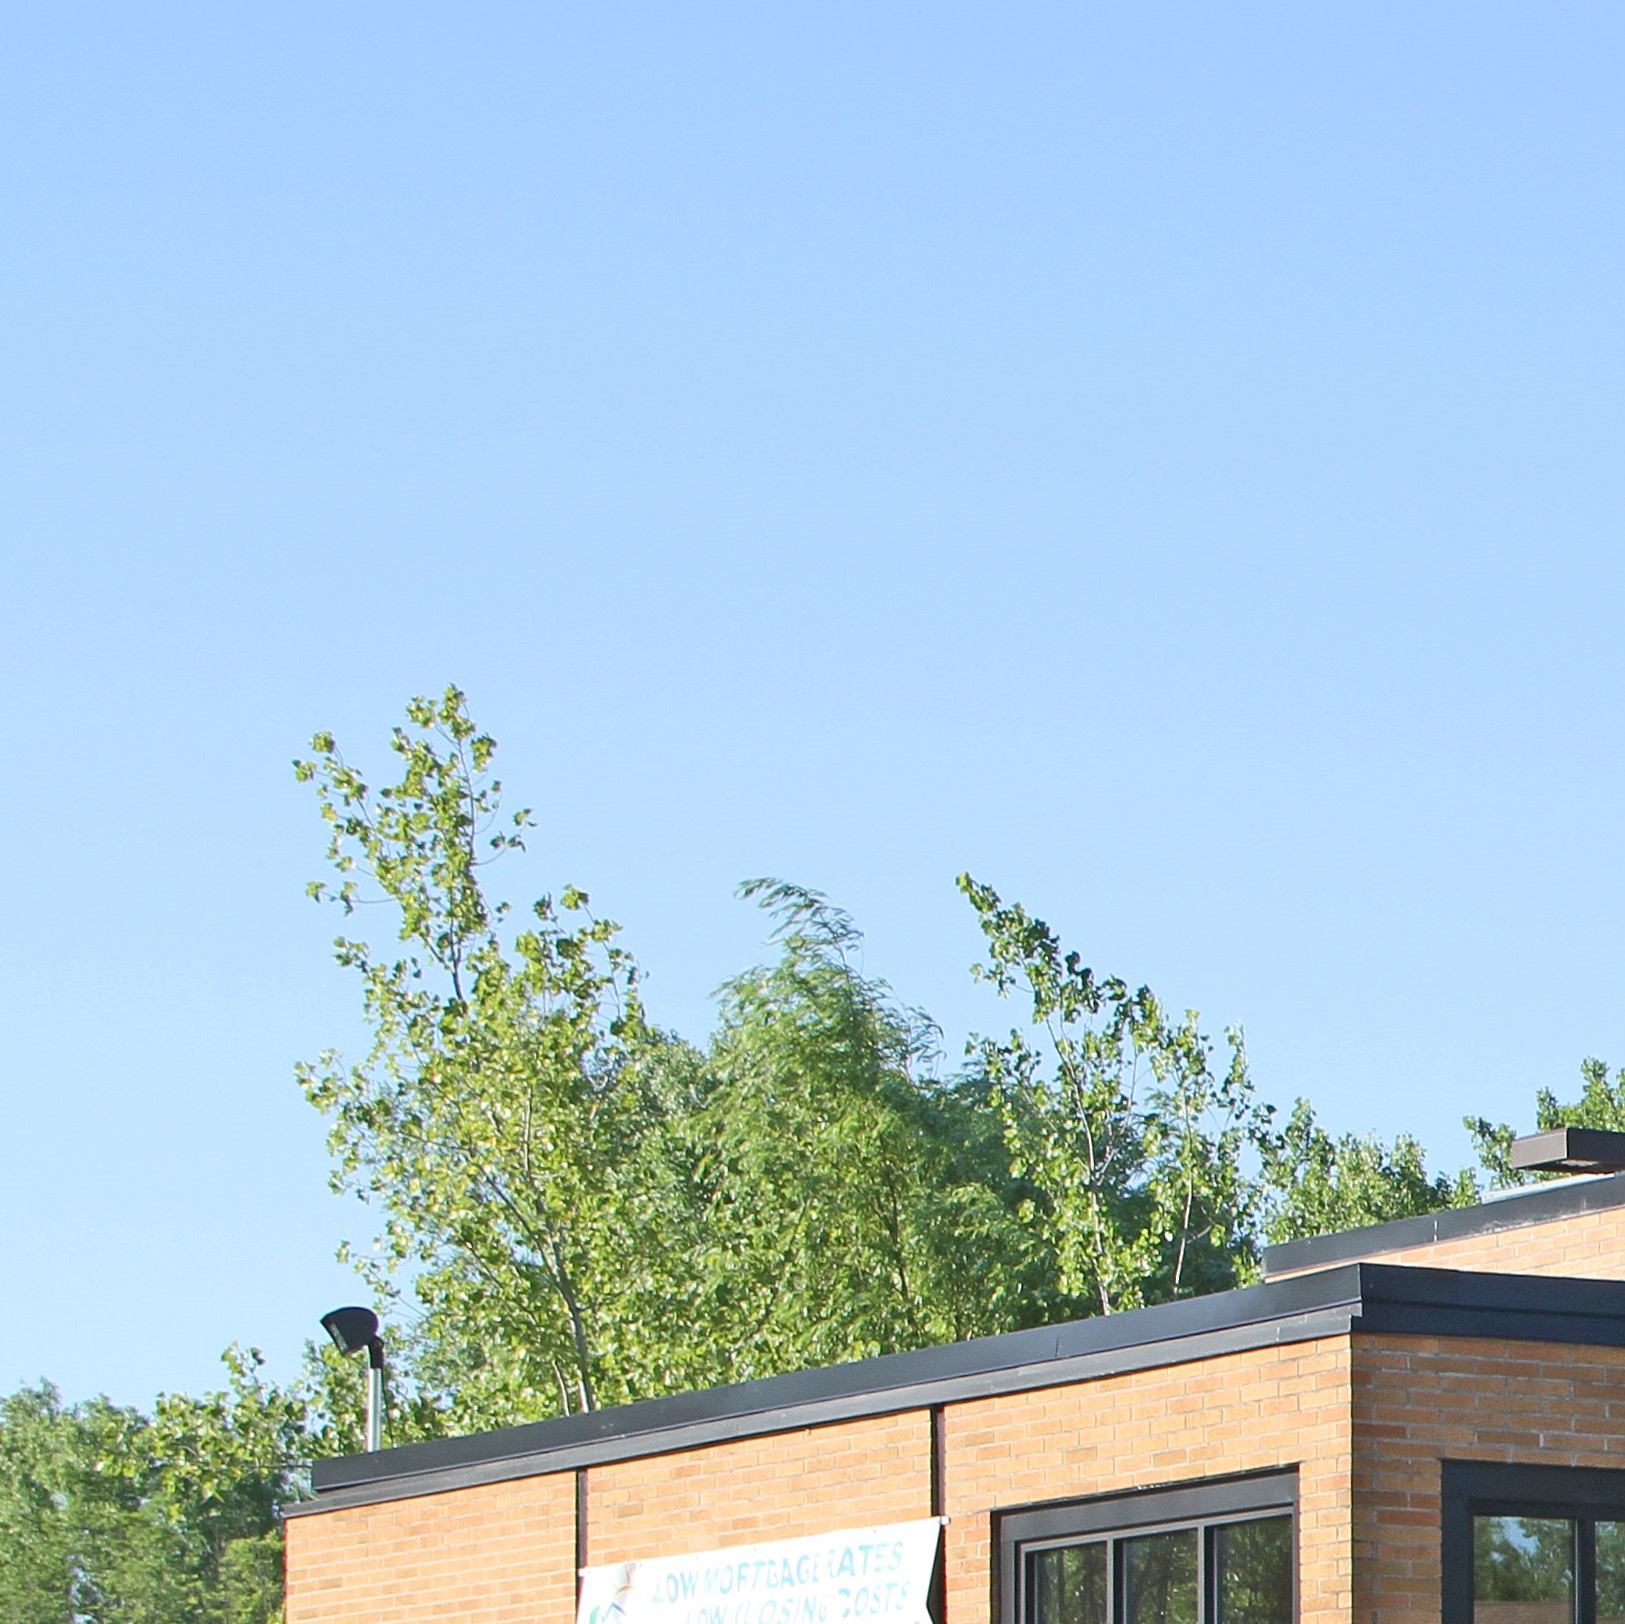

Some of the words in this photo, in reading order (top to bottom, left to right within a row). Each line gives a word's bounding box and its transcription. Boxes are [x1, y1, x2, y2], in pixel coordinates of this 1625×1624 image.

[651, 1570, 699, 1603] LOW
[704, 1552, 821, 1595] MORTGAGE
[826, 1540, 904, 1579] RATES
